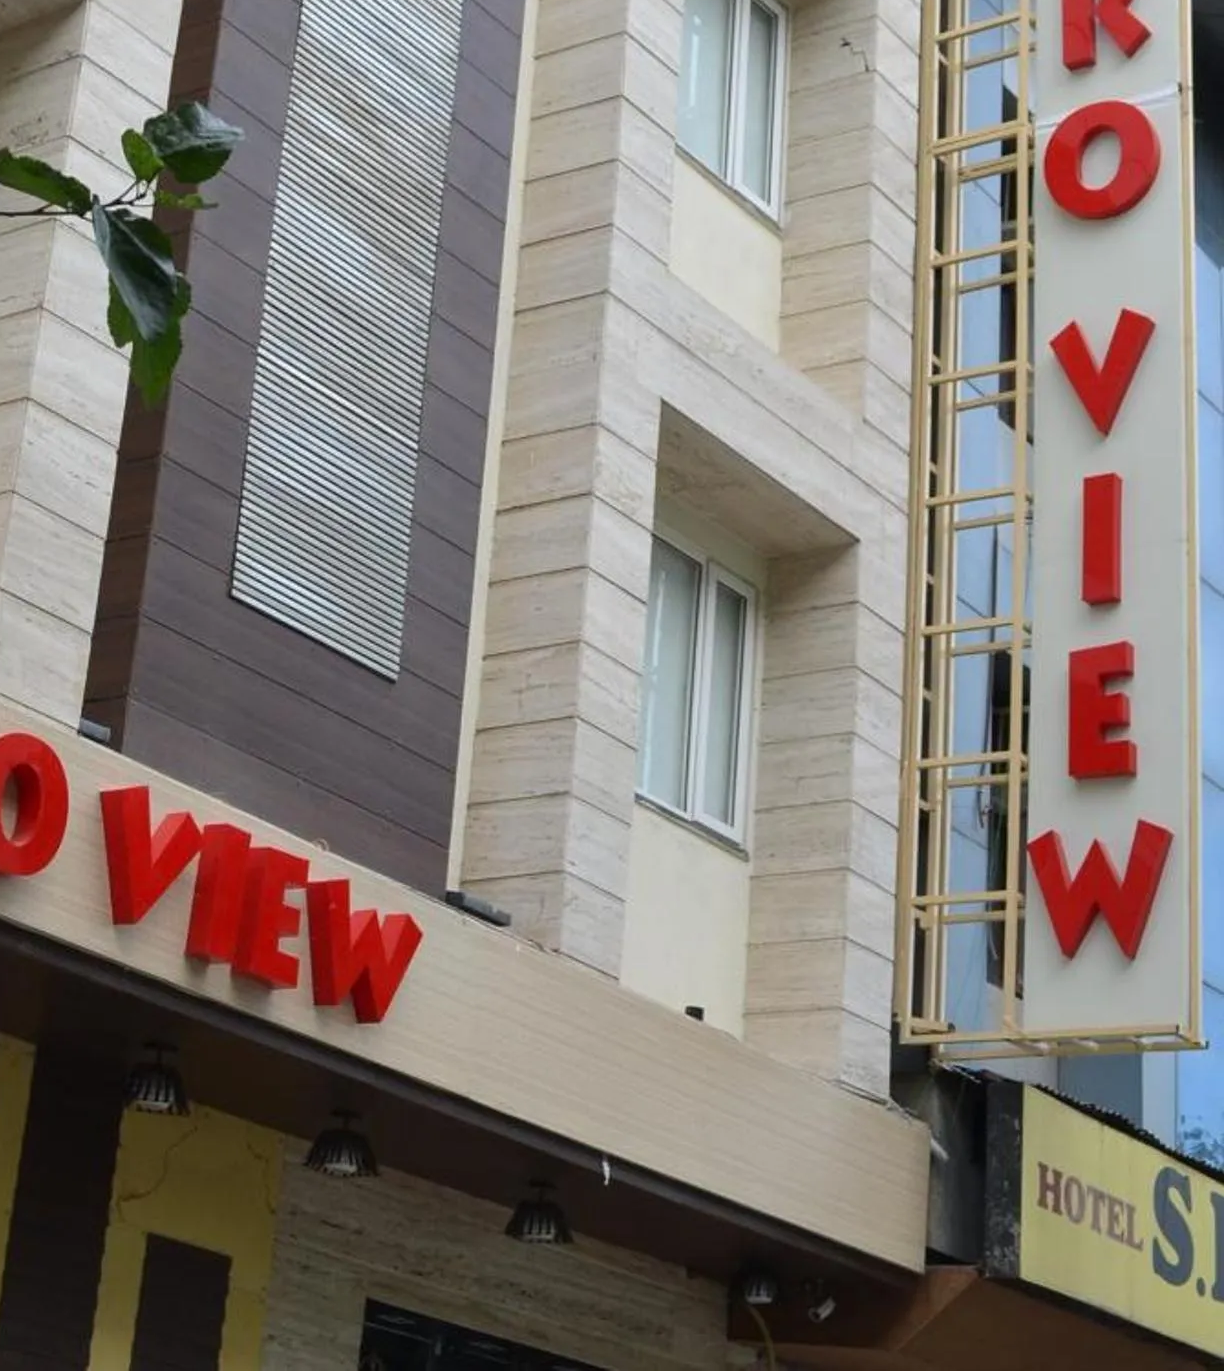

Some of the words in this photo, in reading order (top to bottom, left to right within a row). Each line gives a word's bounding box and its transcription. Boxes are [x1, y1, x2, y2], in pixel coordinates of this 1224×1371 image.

[1027, 308, 1173, 961] VIEW
[100, 785, 423, 1024] VIEW
[1037, 1161, 1144, 1251] HOTEL
